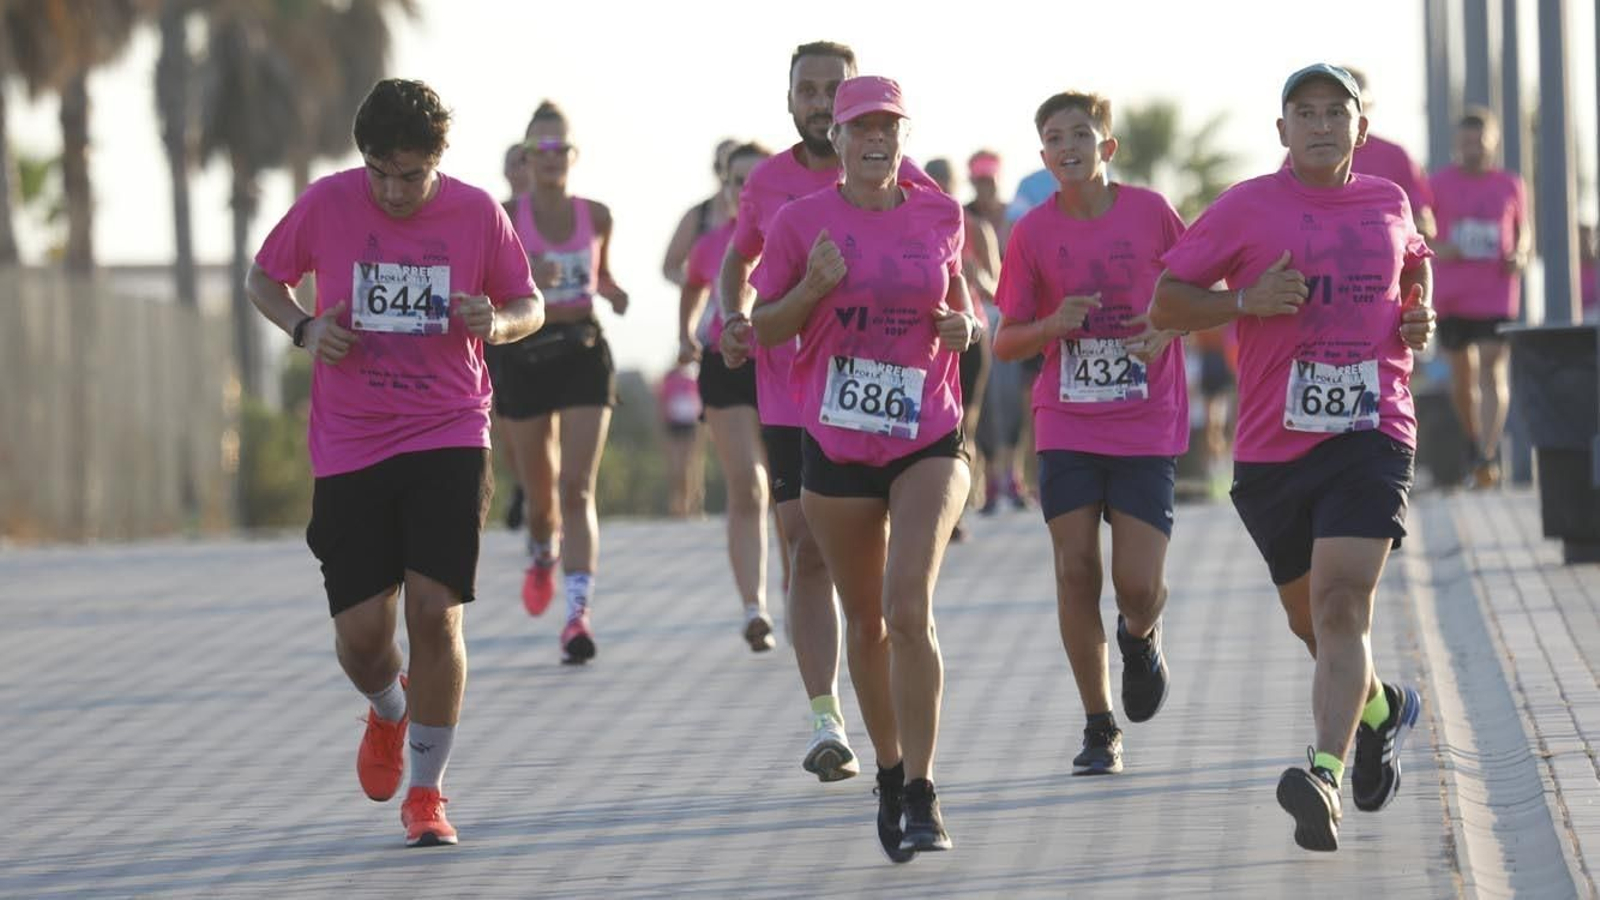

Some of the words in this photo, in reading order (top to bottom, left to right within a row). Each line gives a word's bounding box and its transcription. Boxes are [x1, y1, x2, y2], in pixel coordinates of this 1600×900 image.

[360, 262, 380, 281] VI
[368, 284, 434, 317] 644
[834, 306, 869, 332] VI
[834, 355, 855, 376] VI
[1074, 356, 1133, 387] 432
[1297, 360, 1316, 380] VI
[838, 378, 906, 419] 686
[1302, 383, 1367, 416] 687
